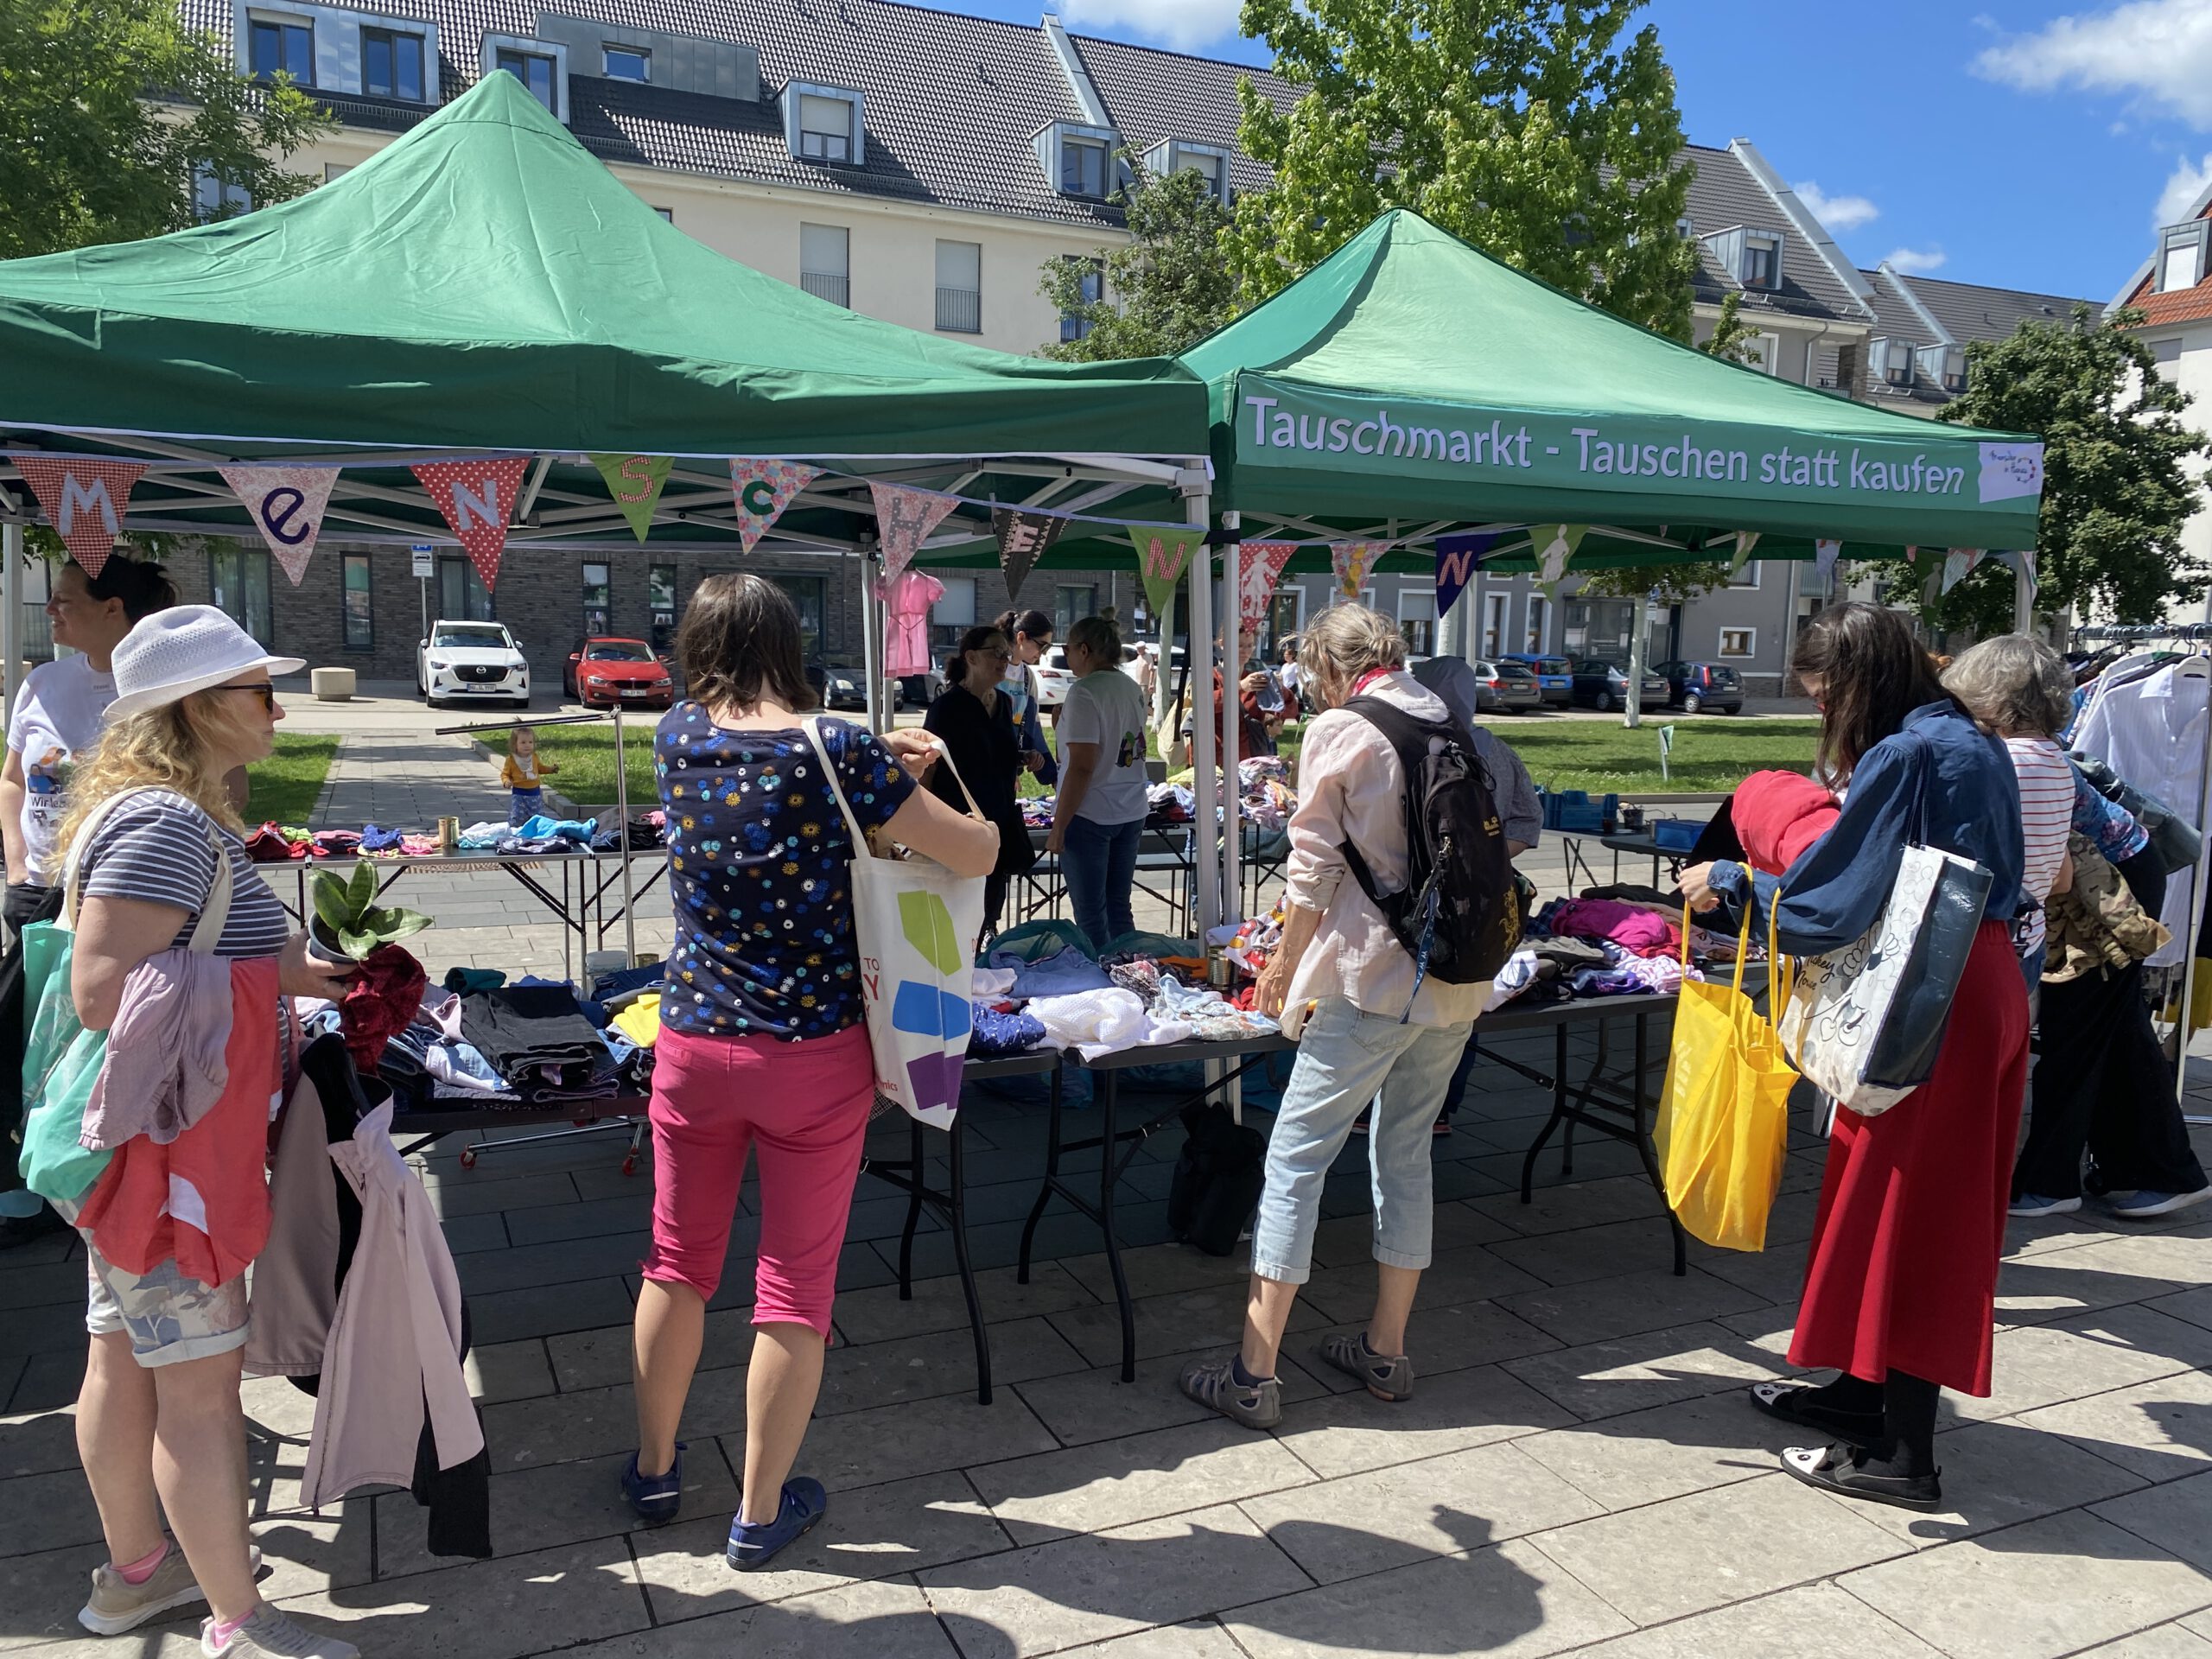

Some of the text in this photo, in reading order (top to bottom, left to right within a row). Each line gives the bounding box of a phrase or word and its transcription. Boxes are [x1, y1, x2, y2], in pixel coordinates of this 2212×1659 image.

[1245, 396, 1532, 467] Tauschmarkt
[1571, 428, 1748, 481] Tauschen
[1759, 446, 1840, 488] statt
[1850, 448, 1965, 494] kaufen
